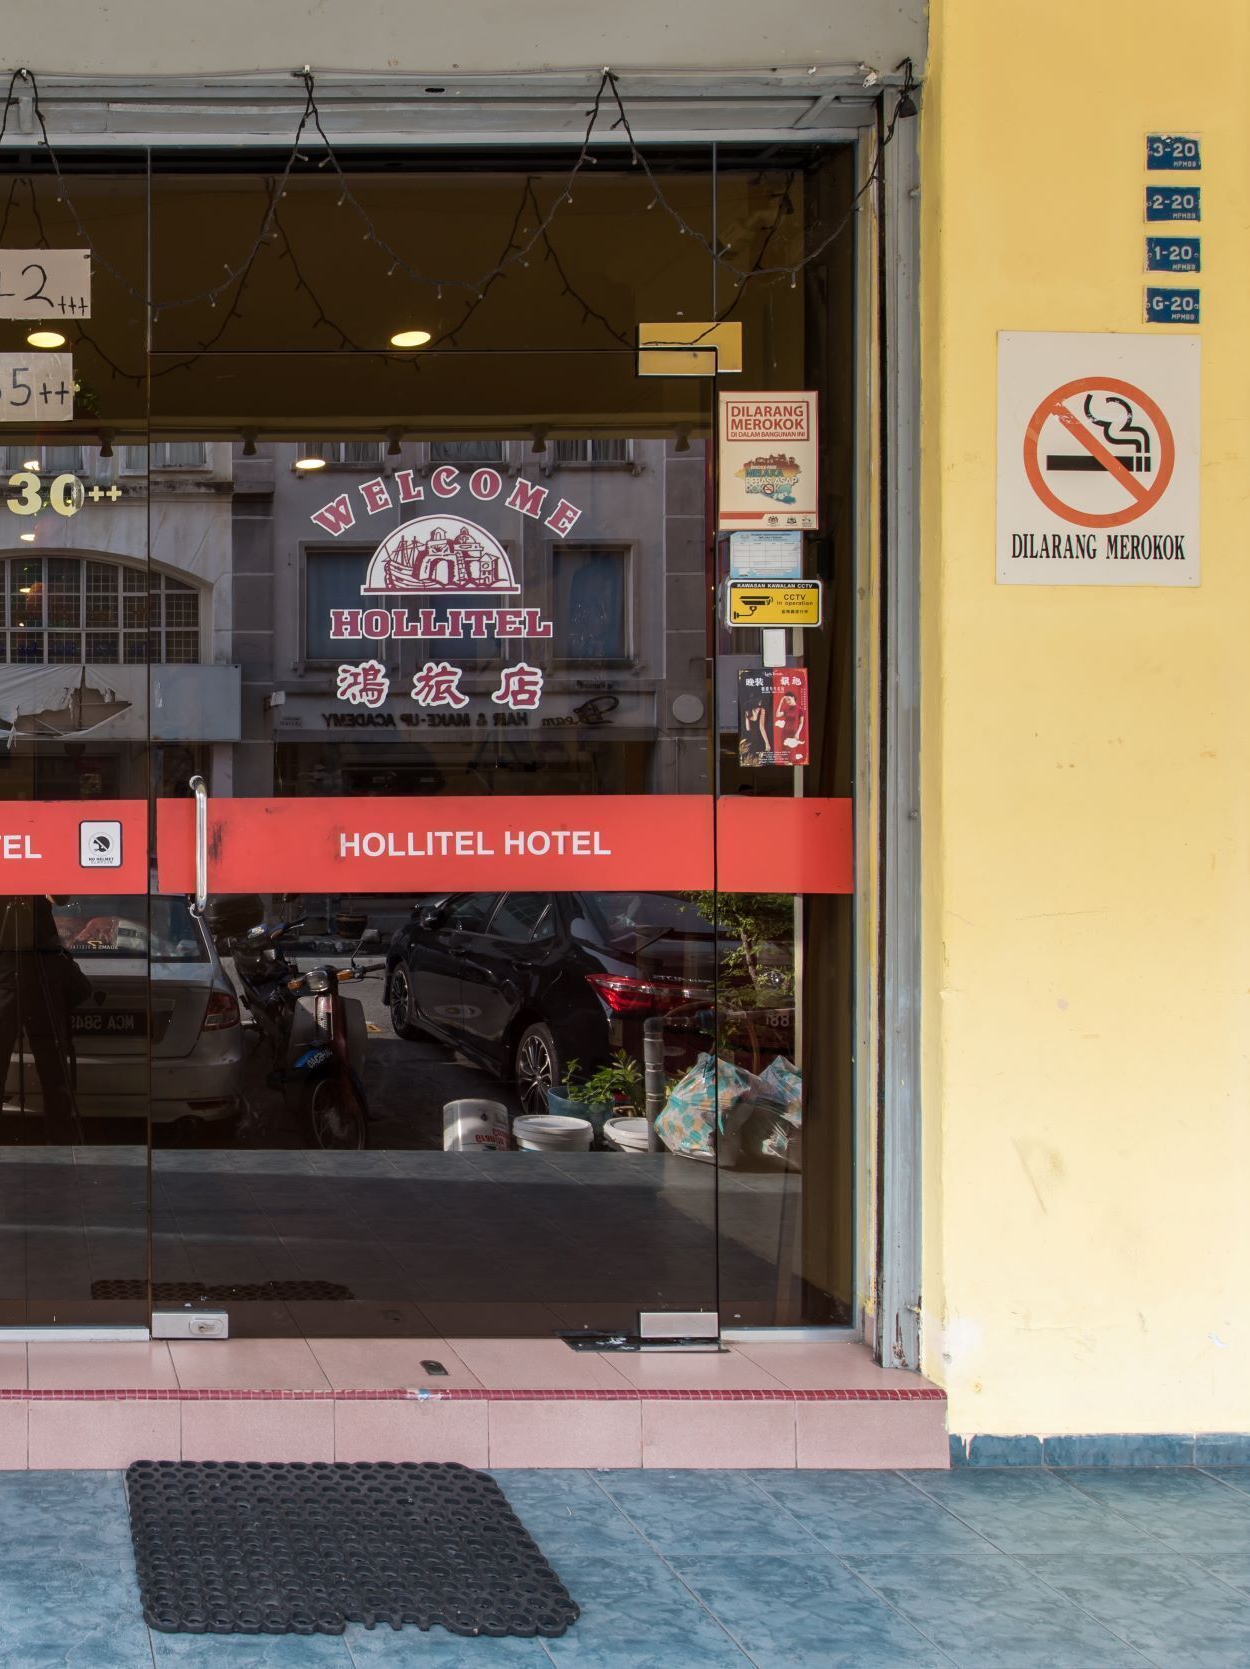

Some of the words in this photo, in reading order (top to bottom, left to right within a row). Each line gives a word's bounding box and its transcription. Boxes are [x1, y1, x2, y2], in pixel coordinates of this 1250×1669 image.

[1153, 143, 1196, 157] 3-20
[1152, 195, 1195, 209] 2-20
[1154, 246, 1193, 260] 1-20
[1152, 296, 1194, 311] G-20
[731, 405, 804, 417] DILARANG
[731, 418, 805, 431] MEROKOK
[310, 466, 582, 538] WELCOME
[1011, 533, 1097, 560] DILARANG
[1106, 533, 1186, 561] MEROKOK
[783, 593, 806, 601] CCTV
[330, 608, 553, 639] HOLLITEL
[340, 831, 495, 857] HOLLITEL
[505, 830, 612, 856] HOTEL
